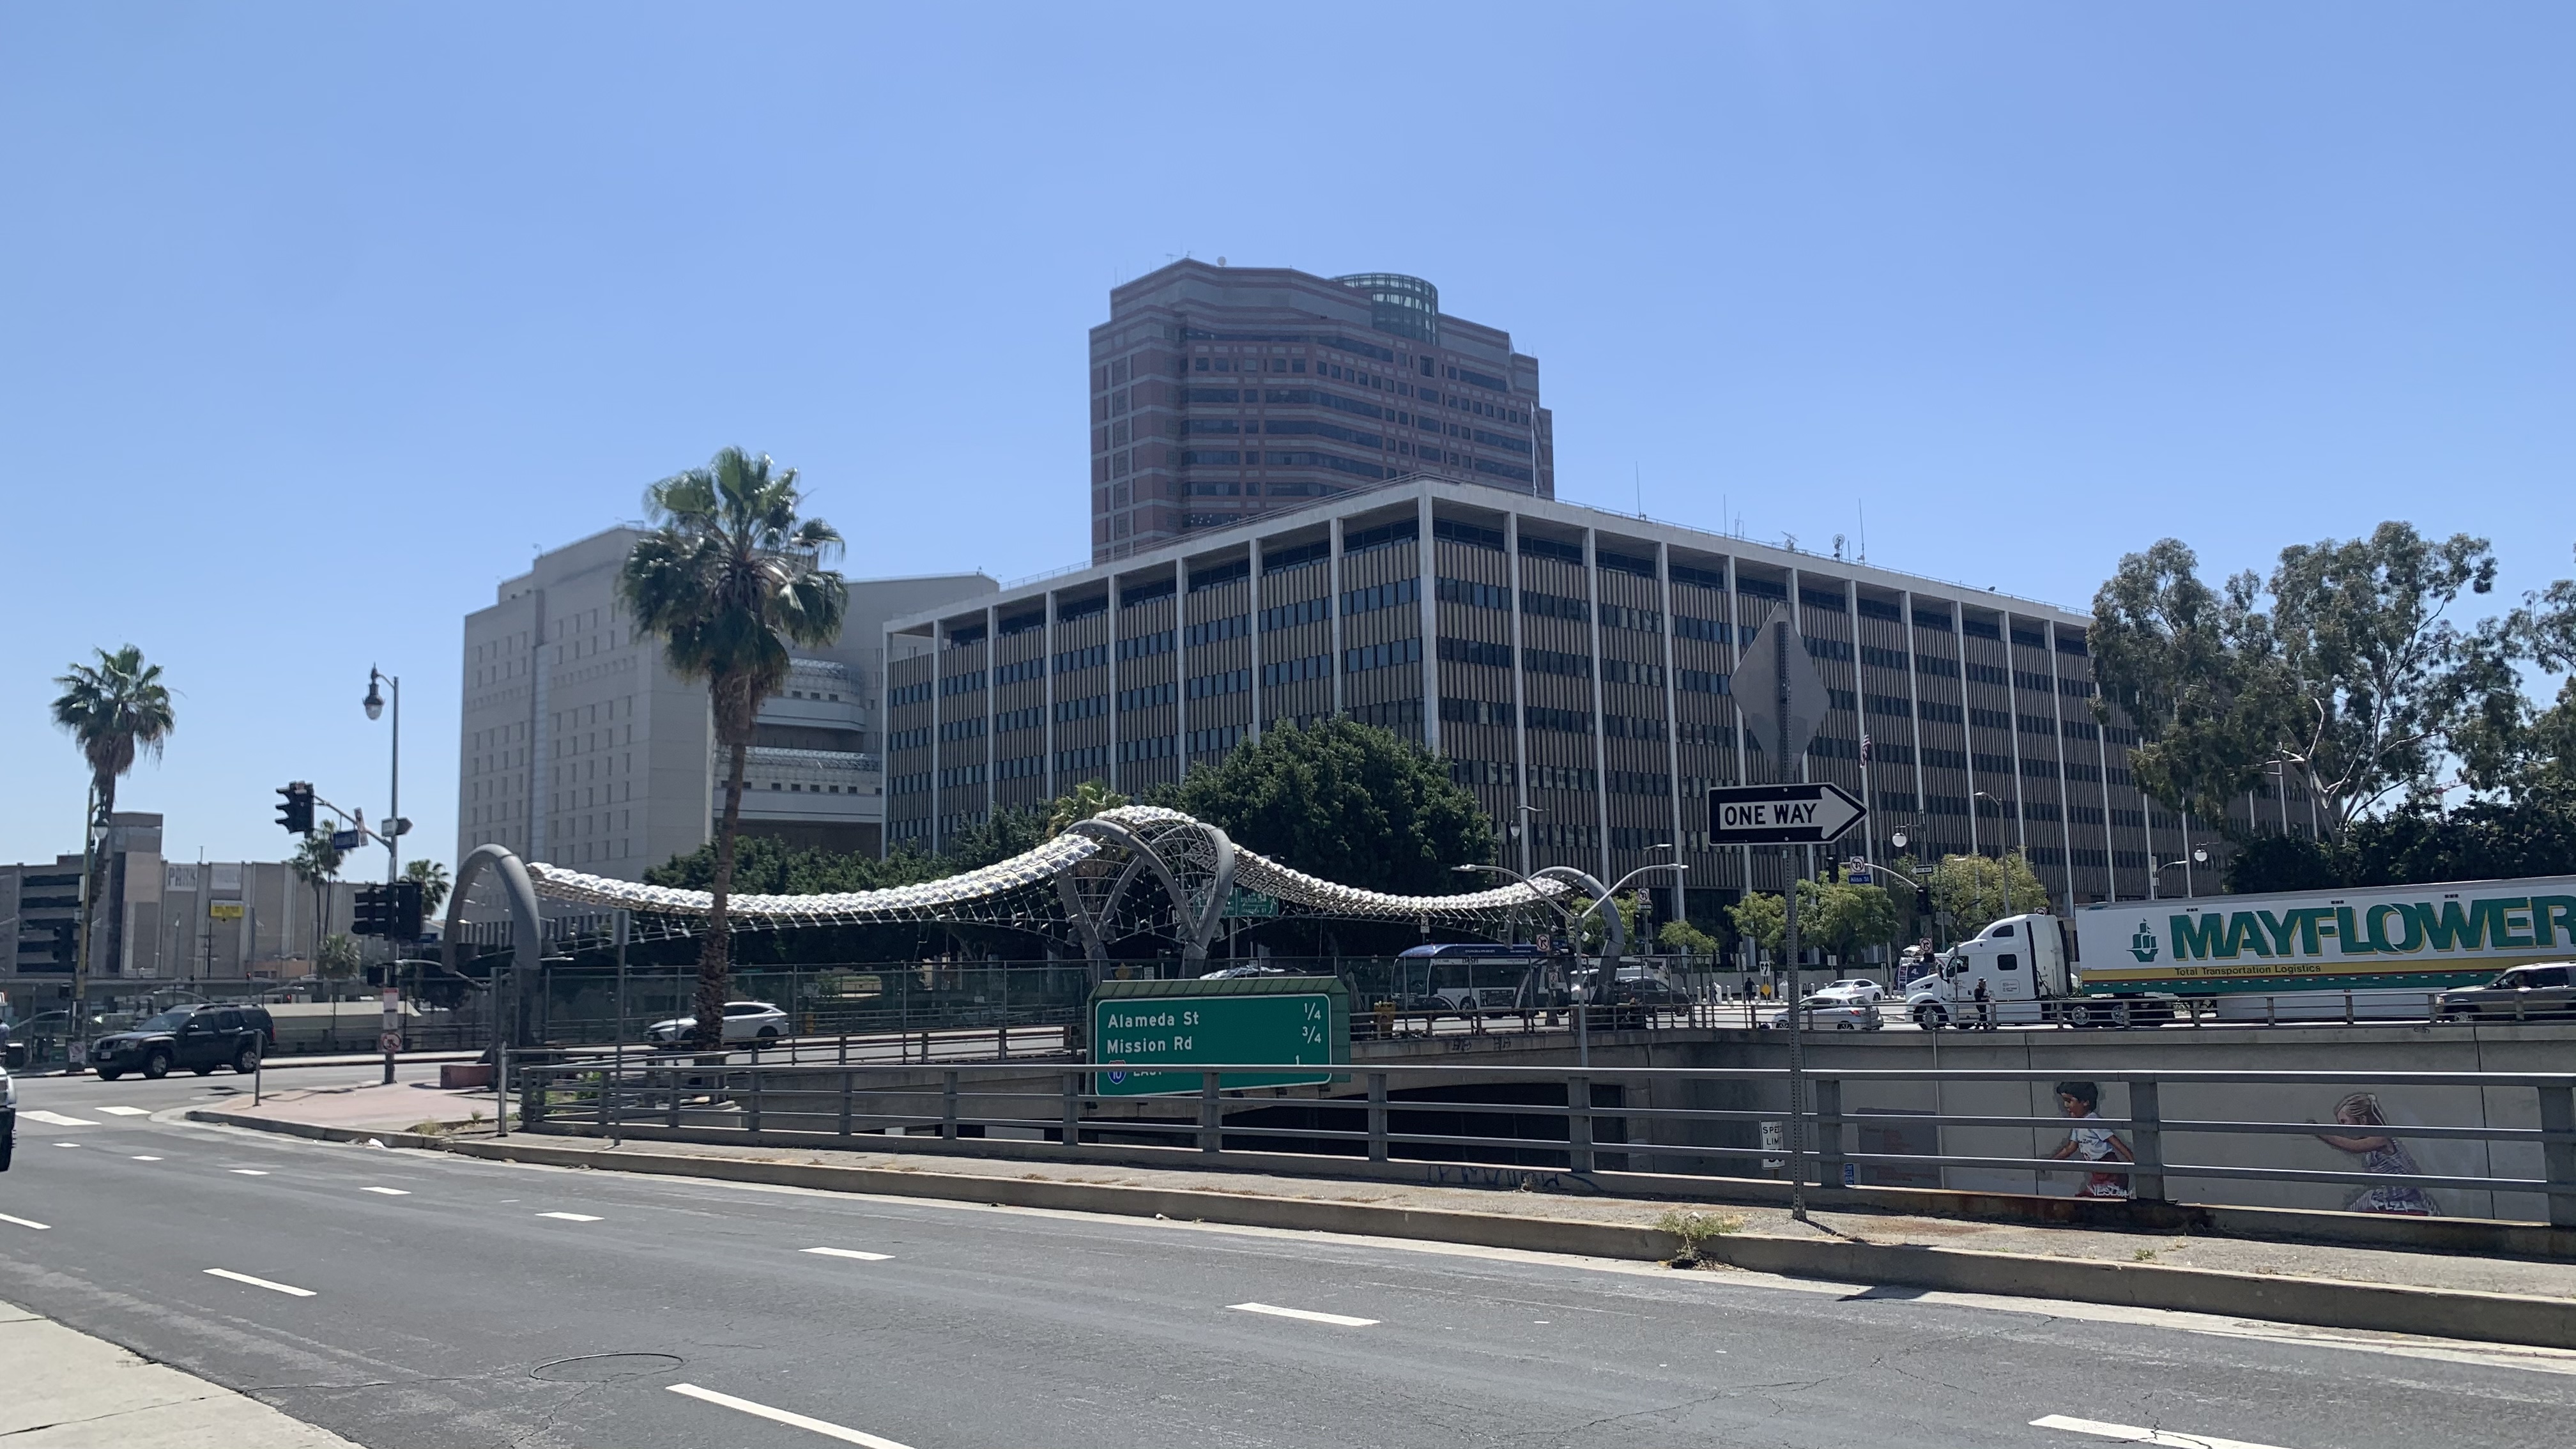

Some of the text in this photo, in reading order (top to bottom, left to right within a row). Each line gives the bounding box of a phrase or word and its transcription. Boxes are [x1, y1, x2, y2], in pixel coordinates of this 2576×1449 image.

[1725, 803, 1817, 826] ONE WAY
[168, 867, 195, 886] PARK
[2169, 894, 2576, 961] MAYFLOWER
[2175, 964, 2320, 976] Total Transportation Logistics
[1107, 1011, 1199, 1029] Alameda St
[1304, 1002, 1321, 1021] 1/4
[1302, 1025, 1321, 1044] 3/4
[1107, 1036, 1192, 1054] Mission Rd
[1763, 1126, 1781, 1134] SPE
